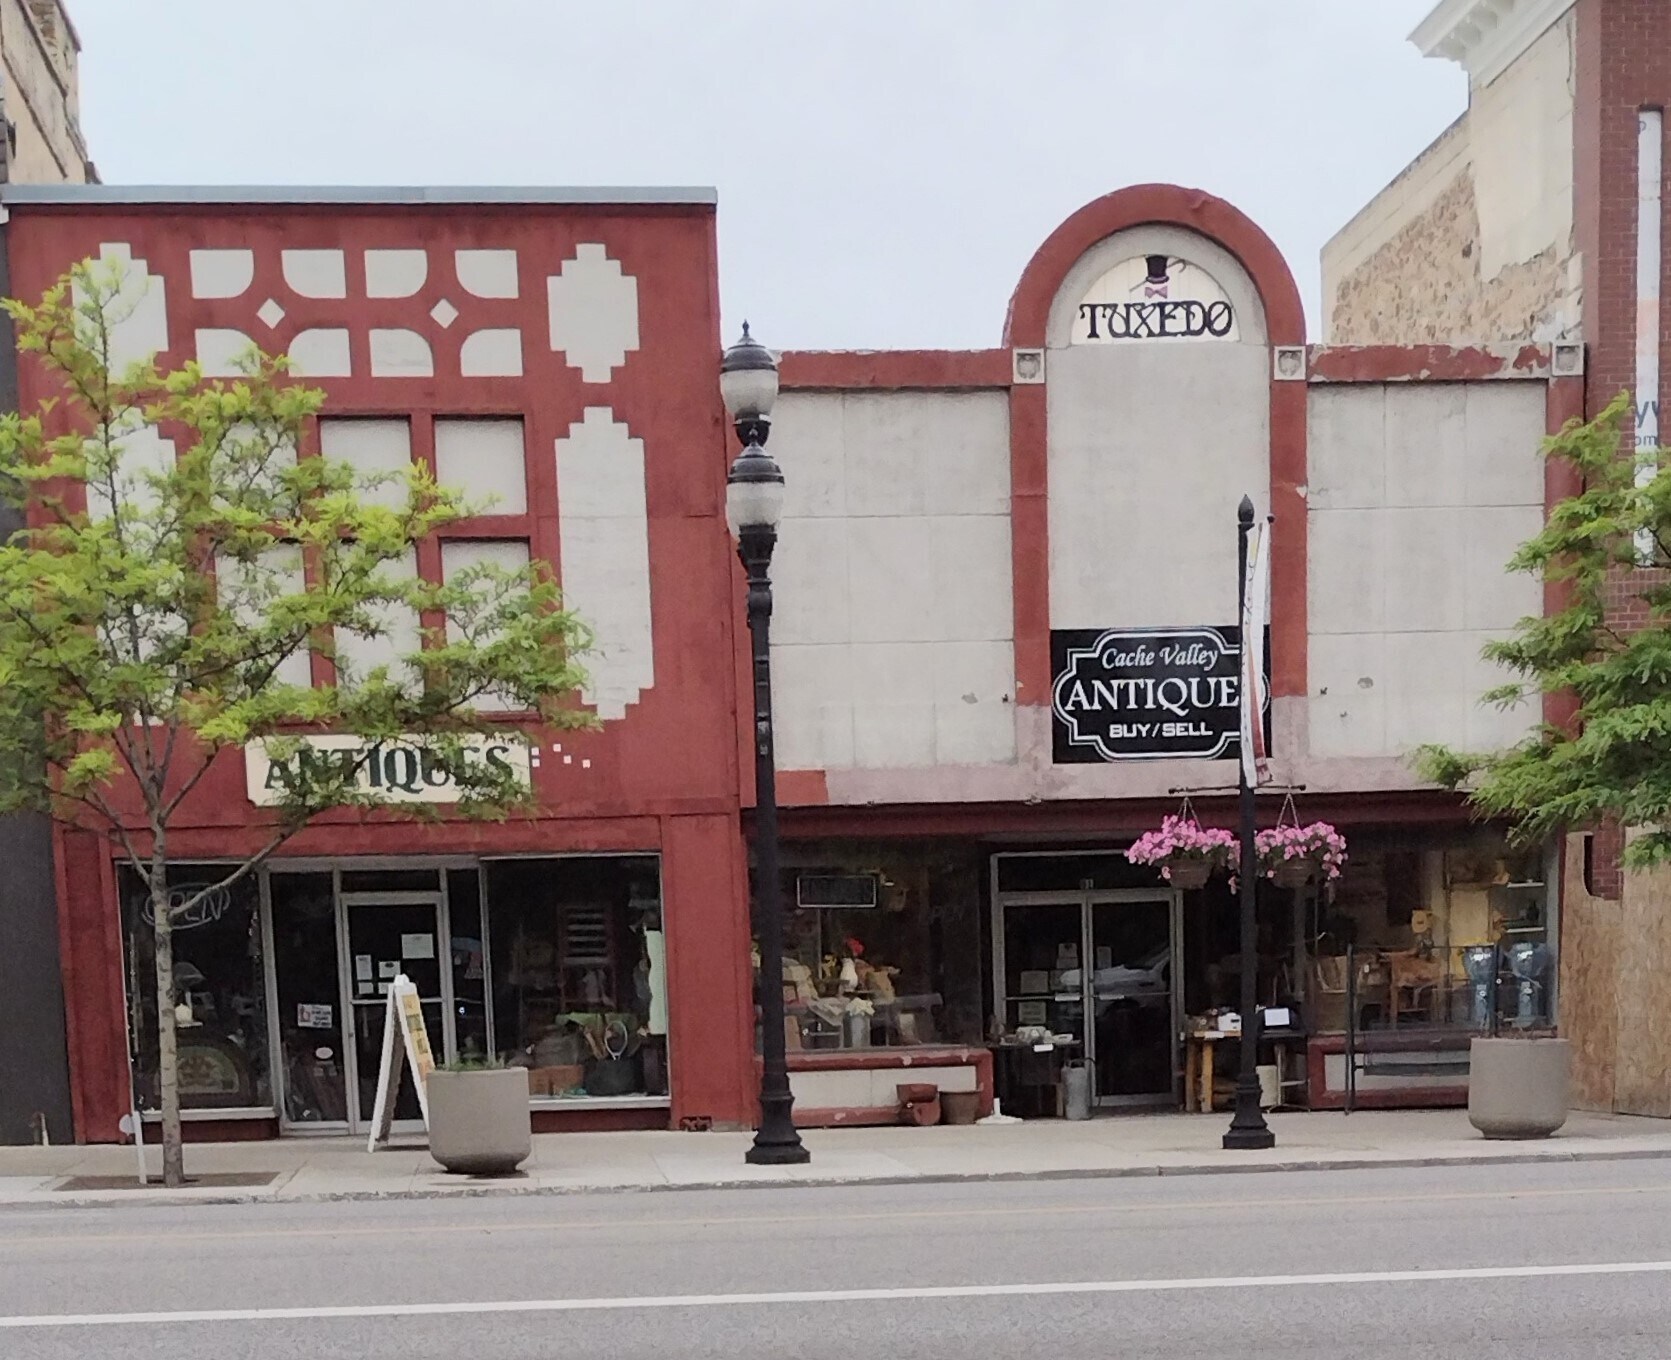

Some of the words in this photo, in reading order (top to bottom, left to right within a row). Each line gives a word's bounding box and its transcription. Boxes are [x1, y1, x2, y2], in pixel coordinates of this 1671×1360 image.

[1079, 300, 1233, 339] TUXEDO
[1102, 644, 1155, 670] Cache
[1159, 643, 1219, 672] Valley
[1064, 676, 1240, 717] ANTIQUE
[1109, 722, 1214, 739] BUY/SELL
